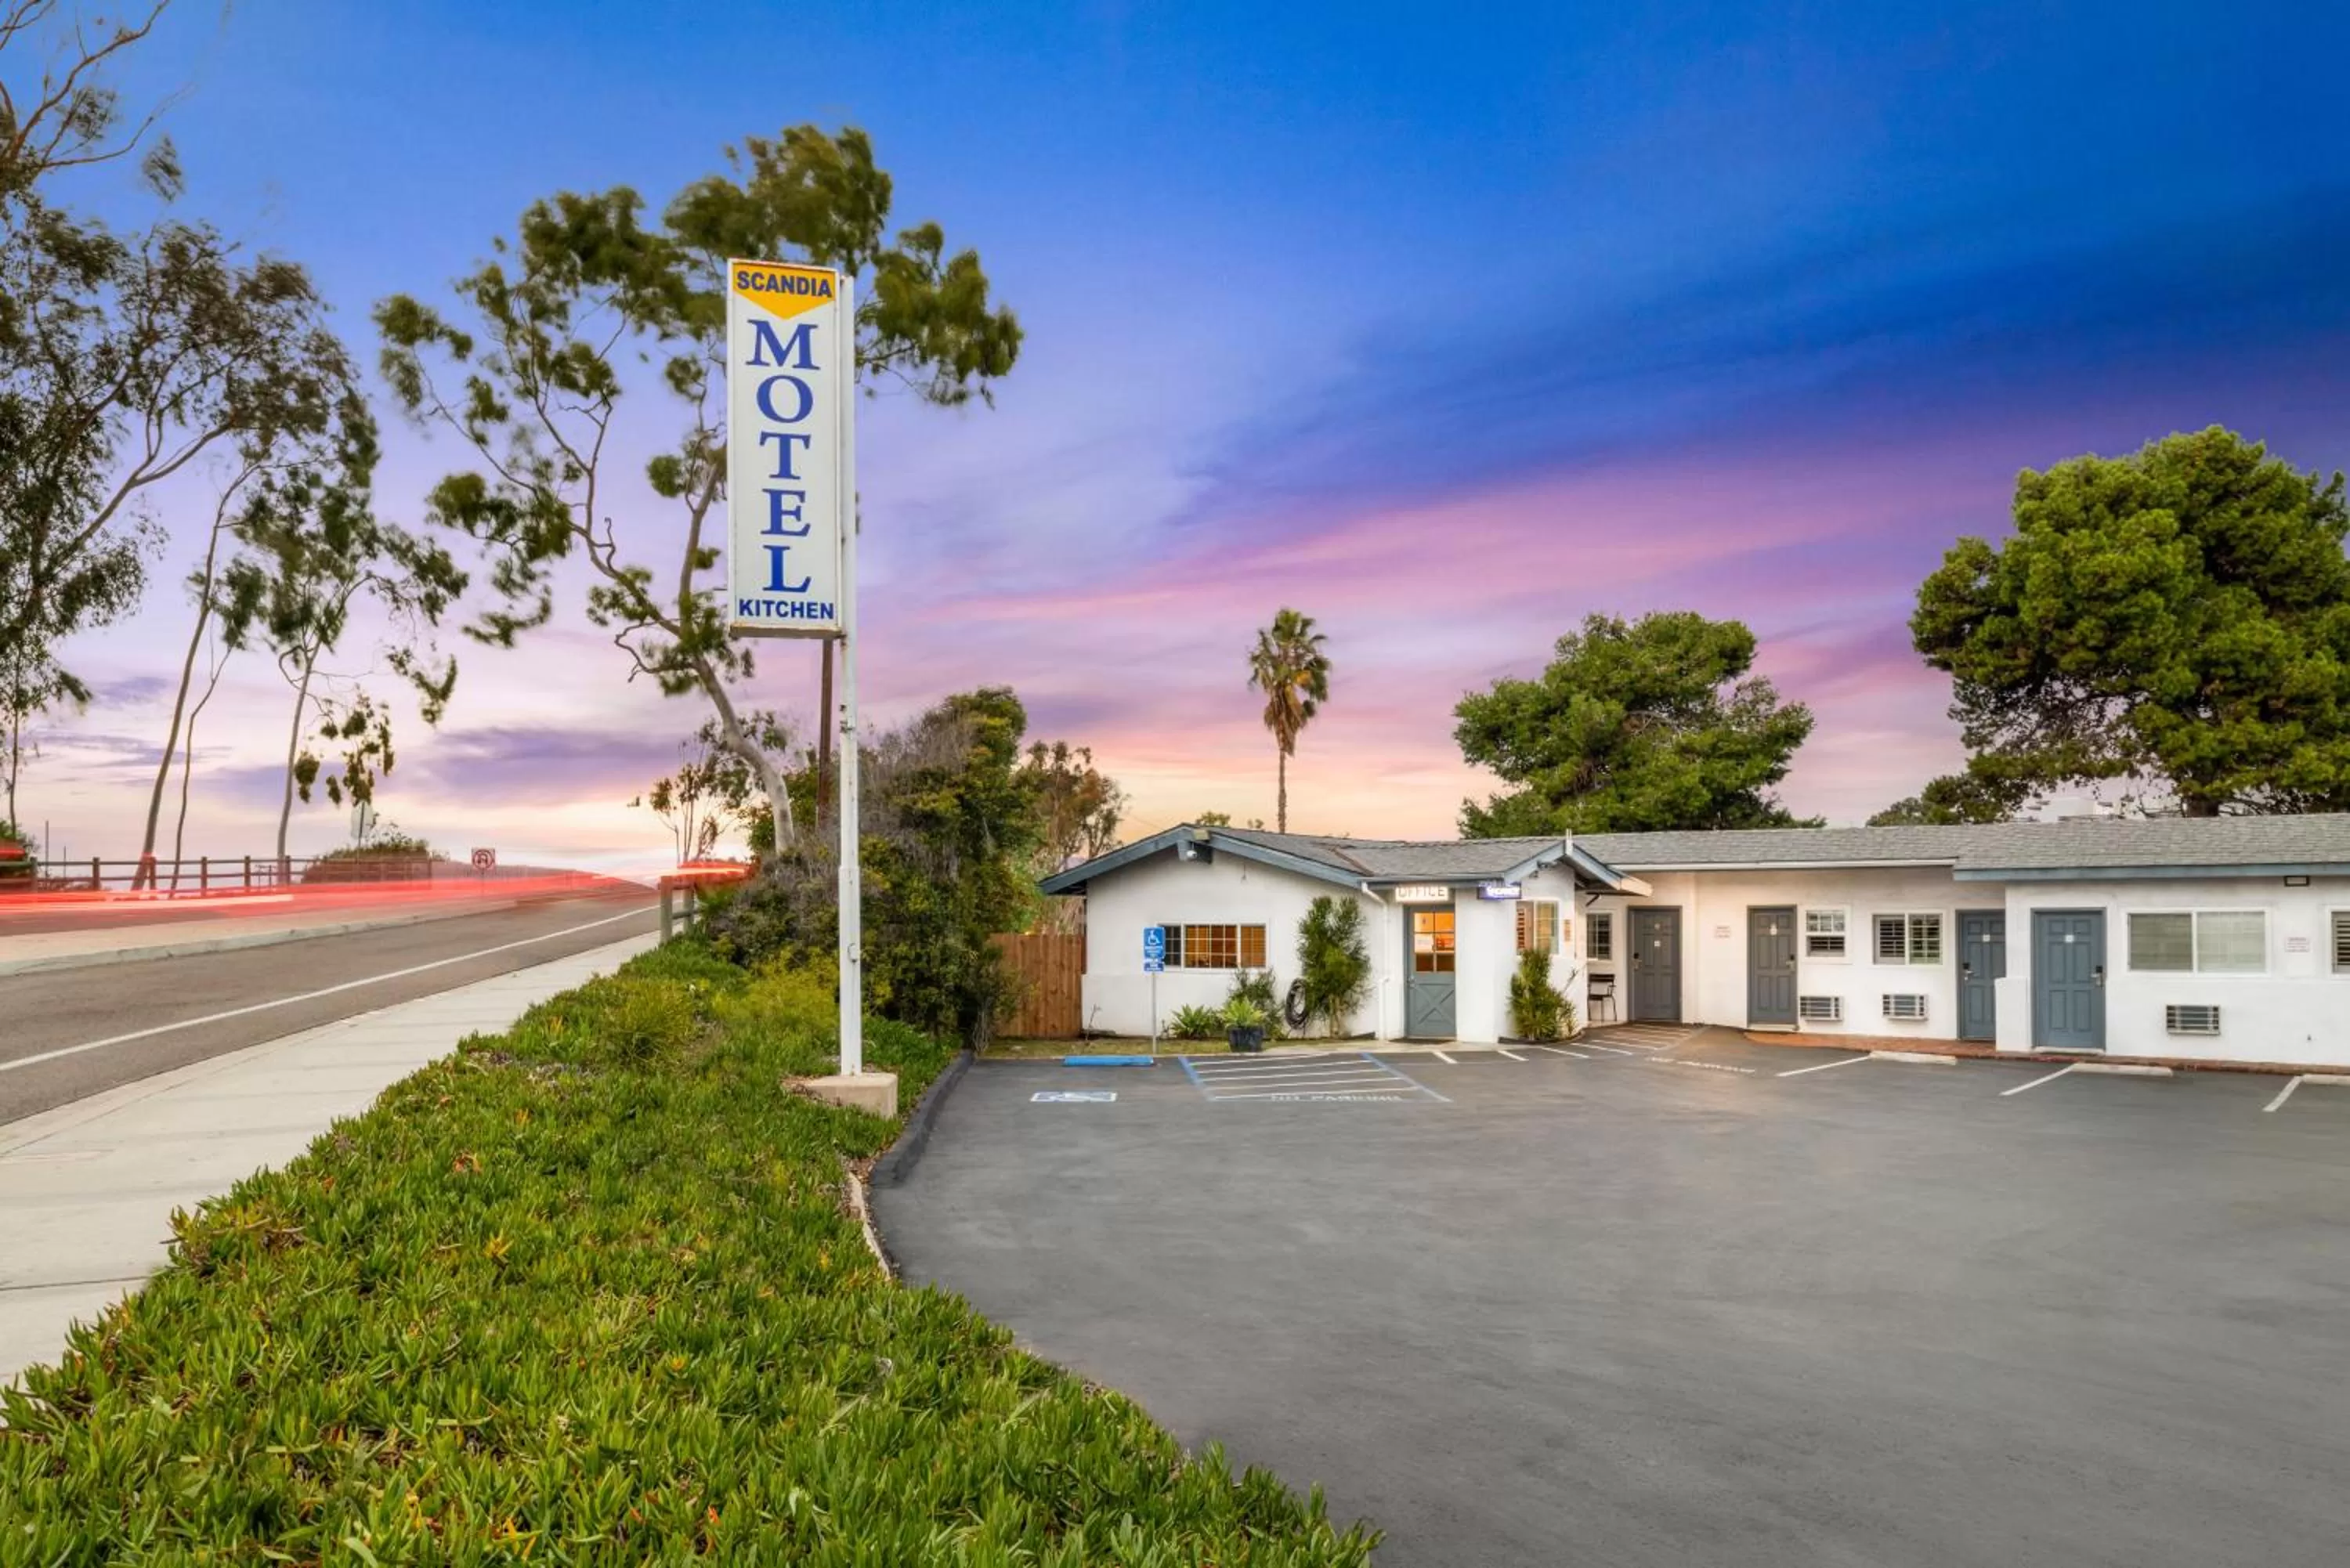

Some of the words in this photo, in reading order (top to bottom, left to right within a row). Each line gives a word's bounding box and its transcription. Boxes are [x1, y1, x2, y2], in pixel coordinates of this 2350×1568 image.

[737, 270, 833, 298] SCANDIA
[746, 319, 821, 593] MOTEL
[739, 598, 833, 620] KITCHEN
[1397, 886, 1446, 898] OFFICE
